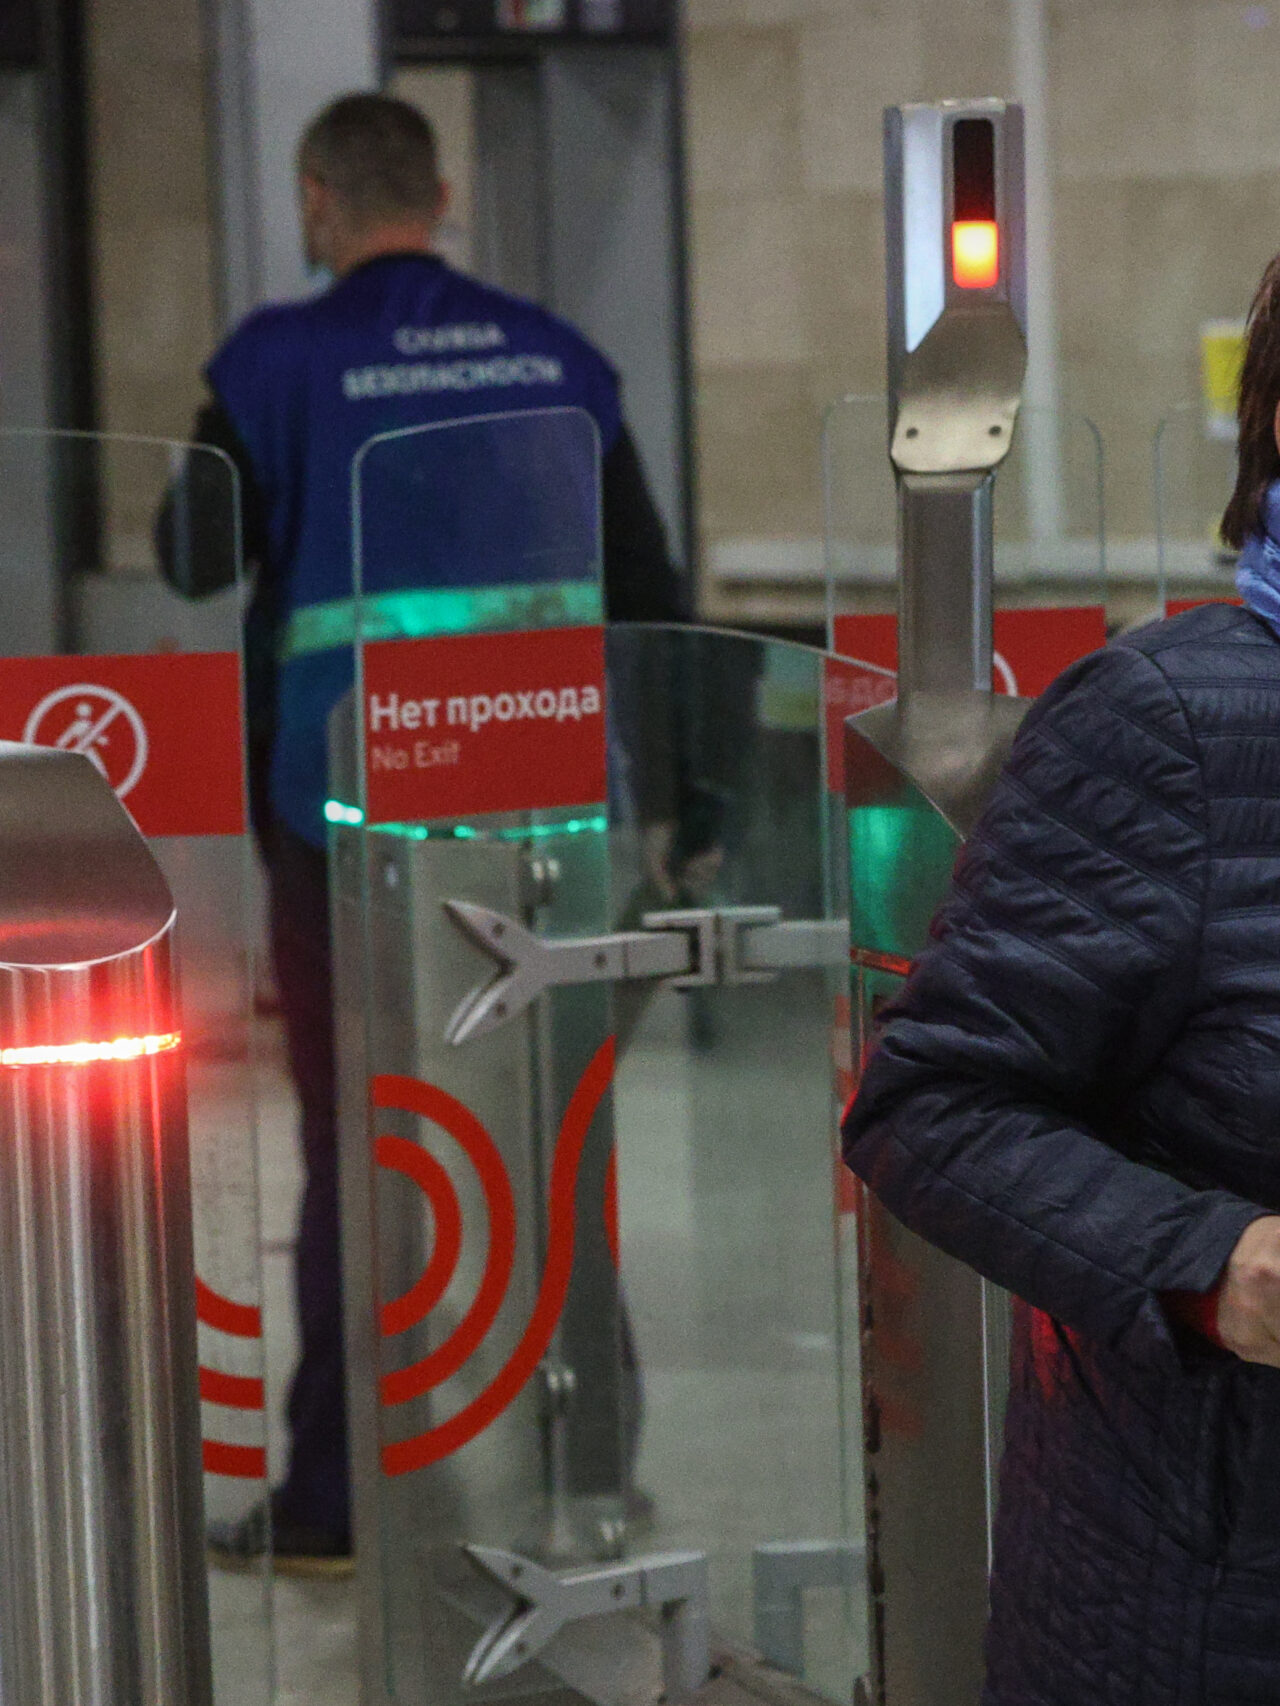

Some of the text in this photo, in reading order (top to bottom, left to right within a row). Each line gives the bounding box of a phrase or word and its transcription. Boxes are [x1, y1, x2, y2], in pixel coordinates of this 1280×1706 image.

[370, 686, 600, 732] Нет прохода
[371, 740, 460, 771] No Exit
